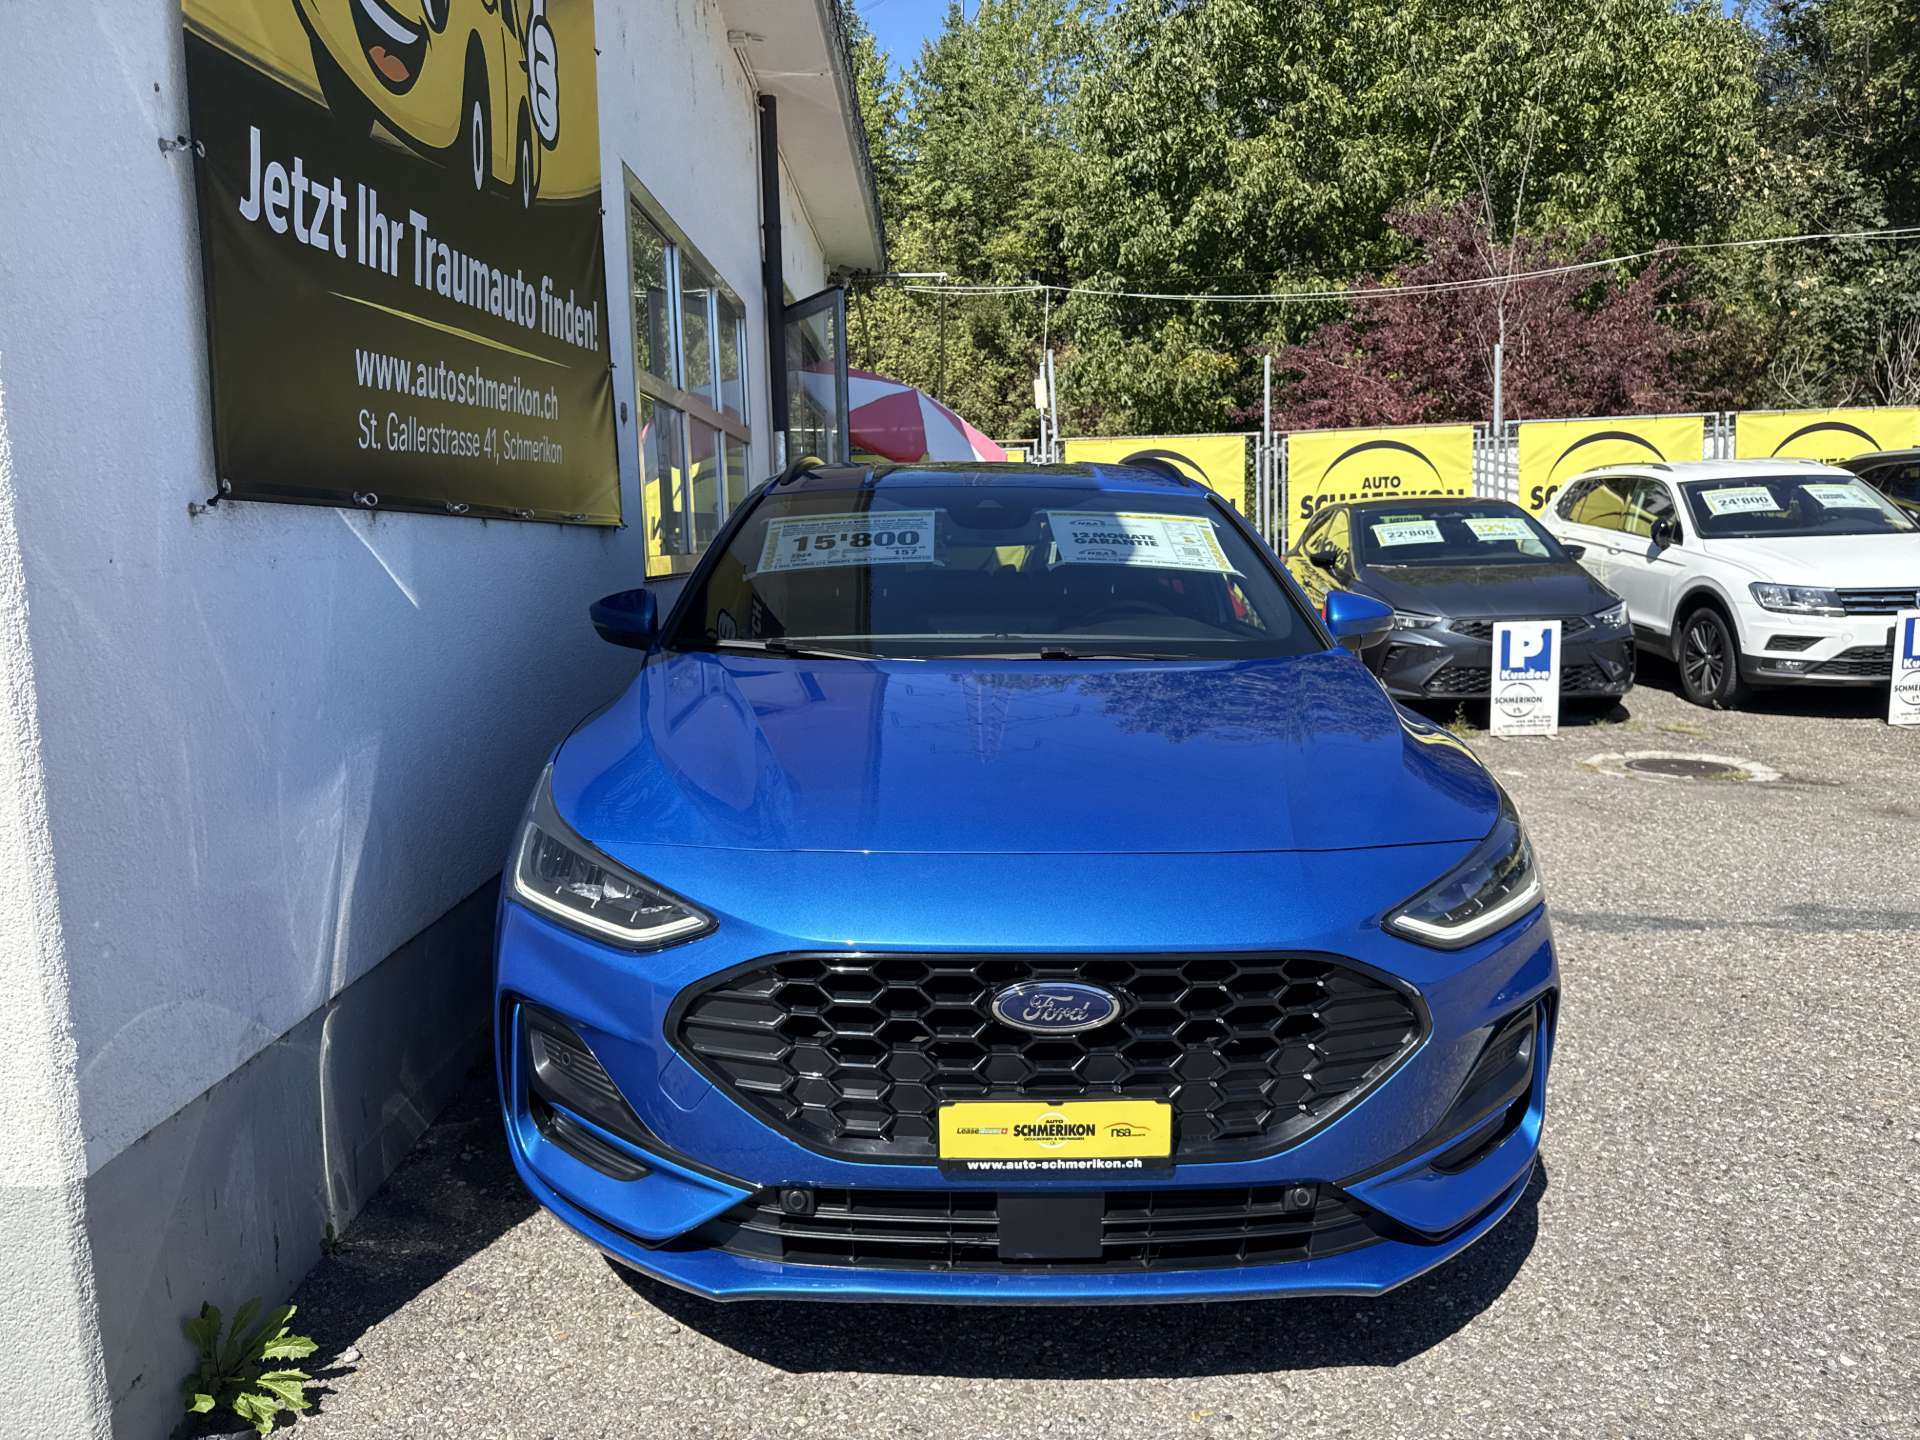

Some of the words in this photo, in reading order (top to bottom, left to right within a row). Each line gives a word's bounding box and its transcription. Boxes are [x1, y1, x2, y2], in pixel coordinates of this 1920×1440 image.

[239, 125, 347, 259] Jetzt
[358, 183, 404, 277] Ihr
[409, 208, 536, 329] Traumauto
[541, 275, 598, 351] finden!
[355, 348, 558, 420] www.autoschmerikon.ch
[358, 408, 381, 450] St.
[386, 412, 480, 457] Gallerstrasse
[483, 427, 500, 465] 41,
[503, 429, 563, 465] Schmerikon
[1362, 476, 1401, 489] AUTO
[793, 531, 920, 552] 15'800
[1074, 538, 1159, 547] GARANTIE
[1096, 532, 1156, 541] MONATE
[1501, 667, 1549, 681] Kunden
[1023, 994, 1090, 1021] Ford
[1013, 1123, 1096, 1137] SCHMERIKON
[967, 1158, 1143, 1170] www.auto-schmerikon.ch
